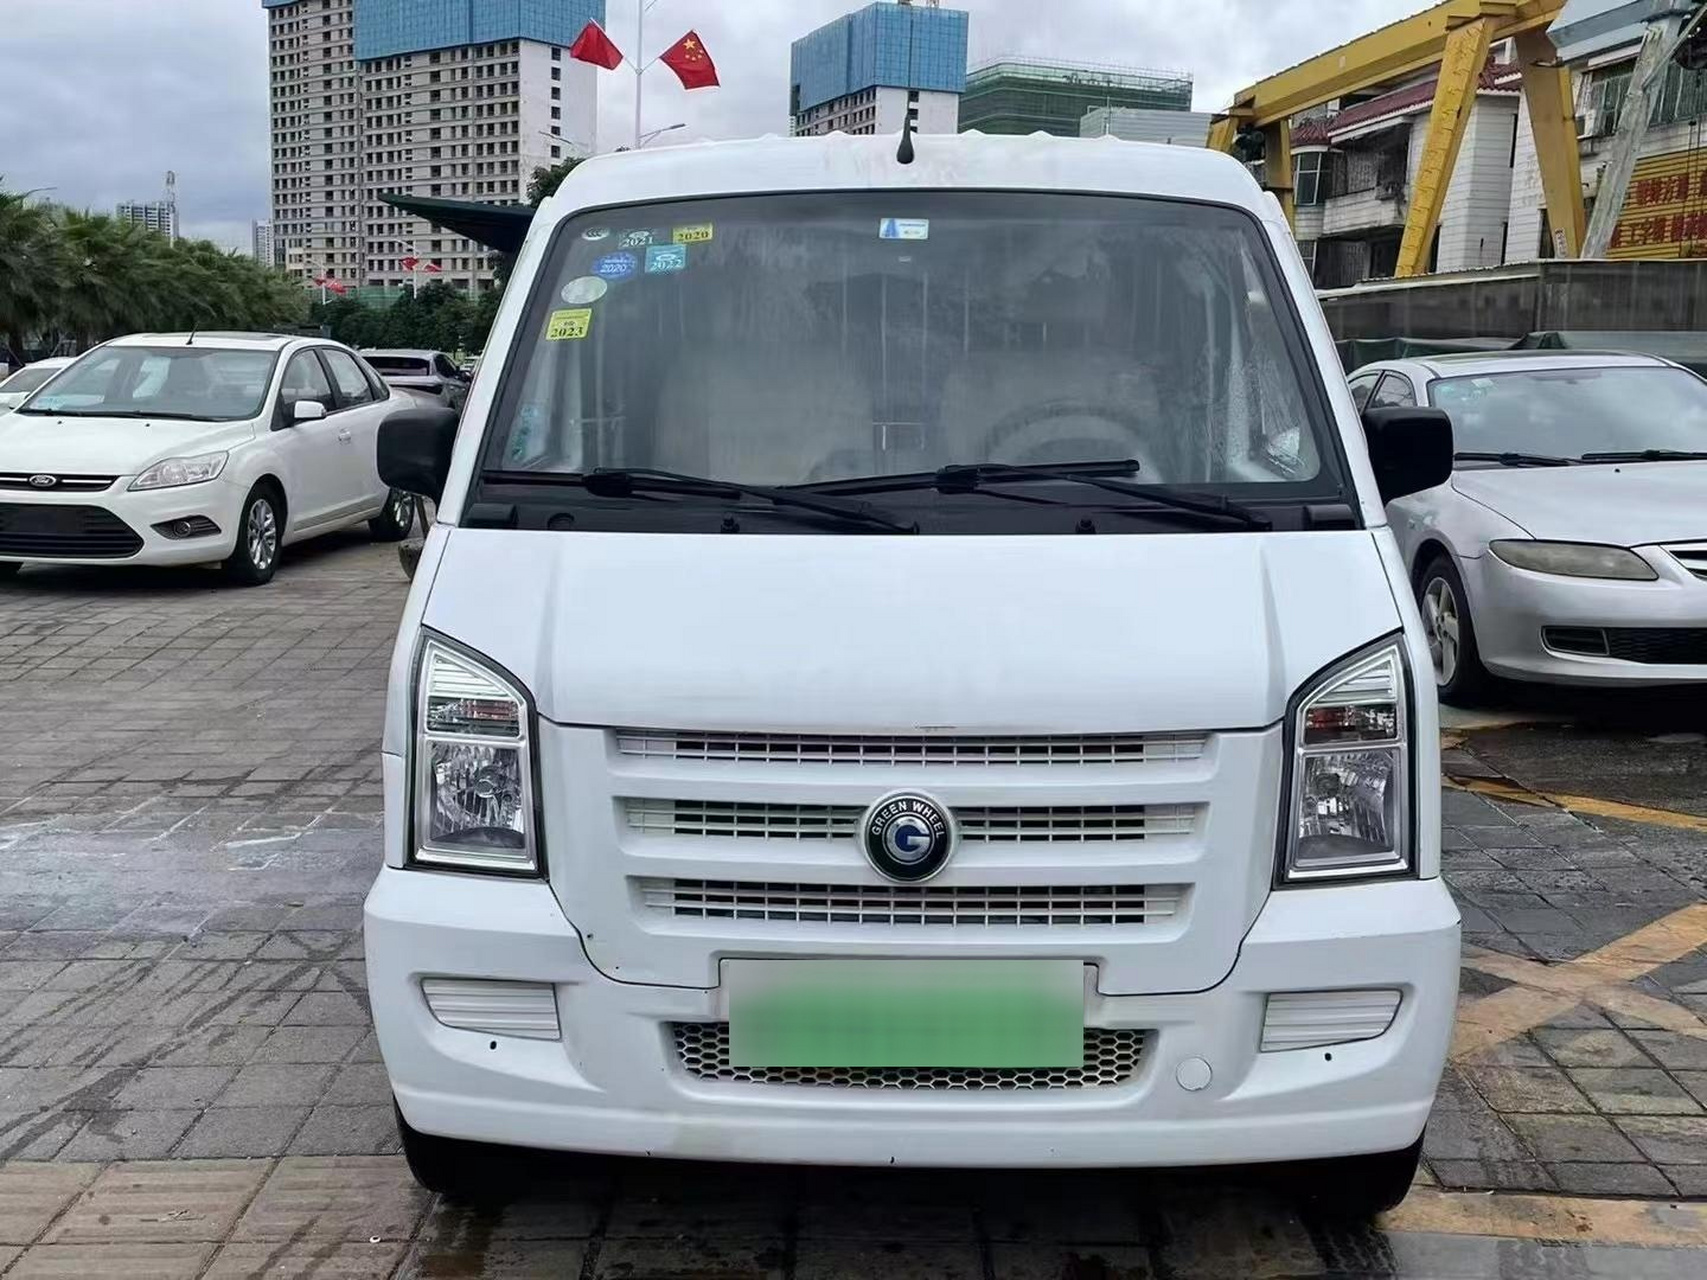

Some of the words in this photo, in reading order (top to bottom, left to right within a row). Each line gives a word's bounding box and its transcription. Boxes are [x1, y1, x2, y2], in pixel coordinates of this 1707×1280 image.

[621, 235, 653, 248] 2021
[677, 231, 709, 241] 2020
[600, 263, 627, 273] 2020
[650, 259, 683, 271] 2022
[550, 326, 584, 338] 2023
[871, 801, 907, 835] GREEN
[912, 801, 945, 839] WHEEL
[886, 816, 931, 861] G
